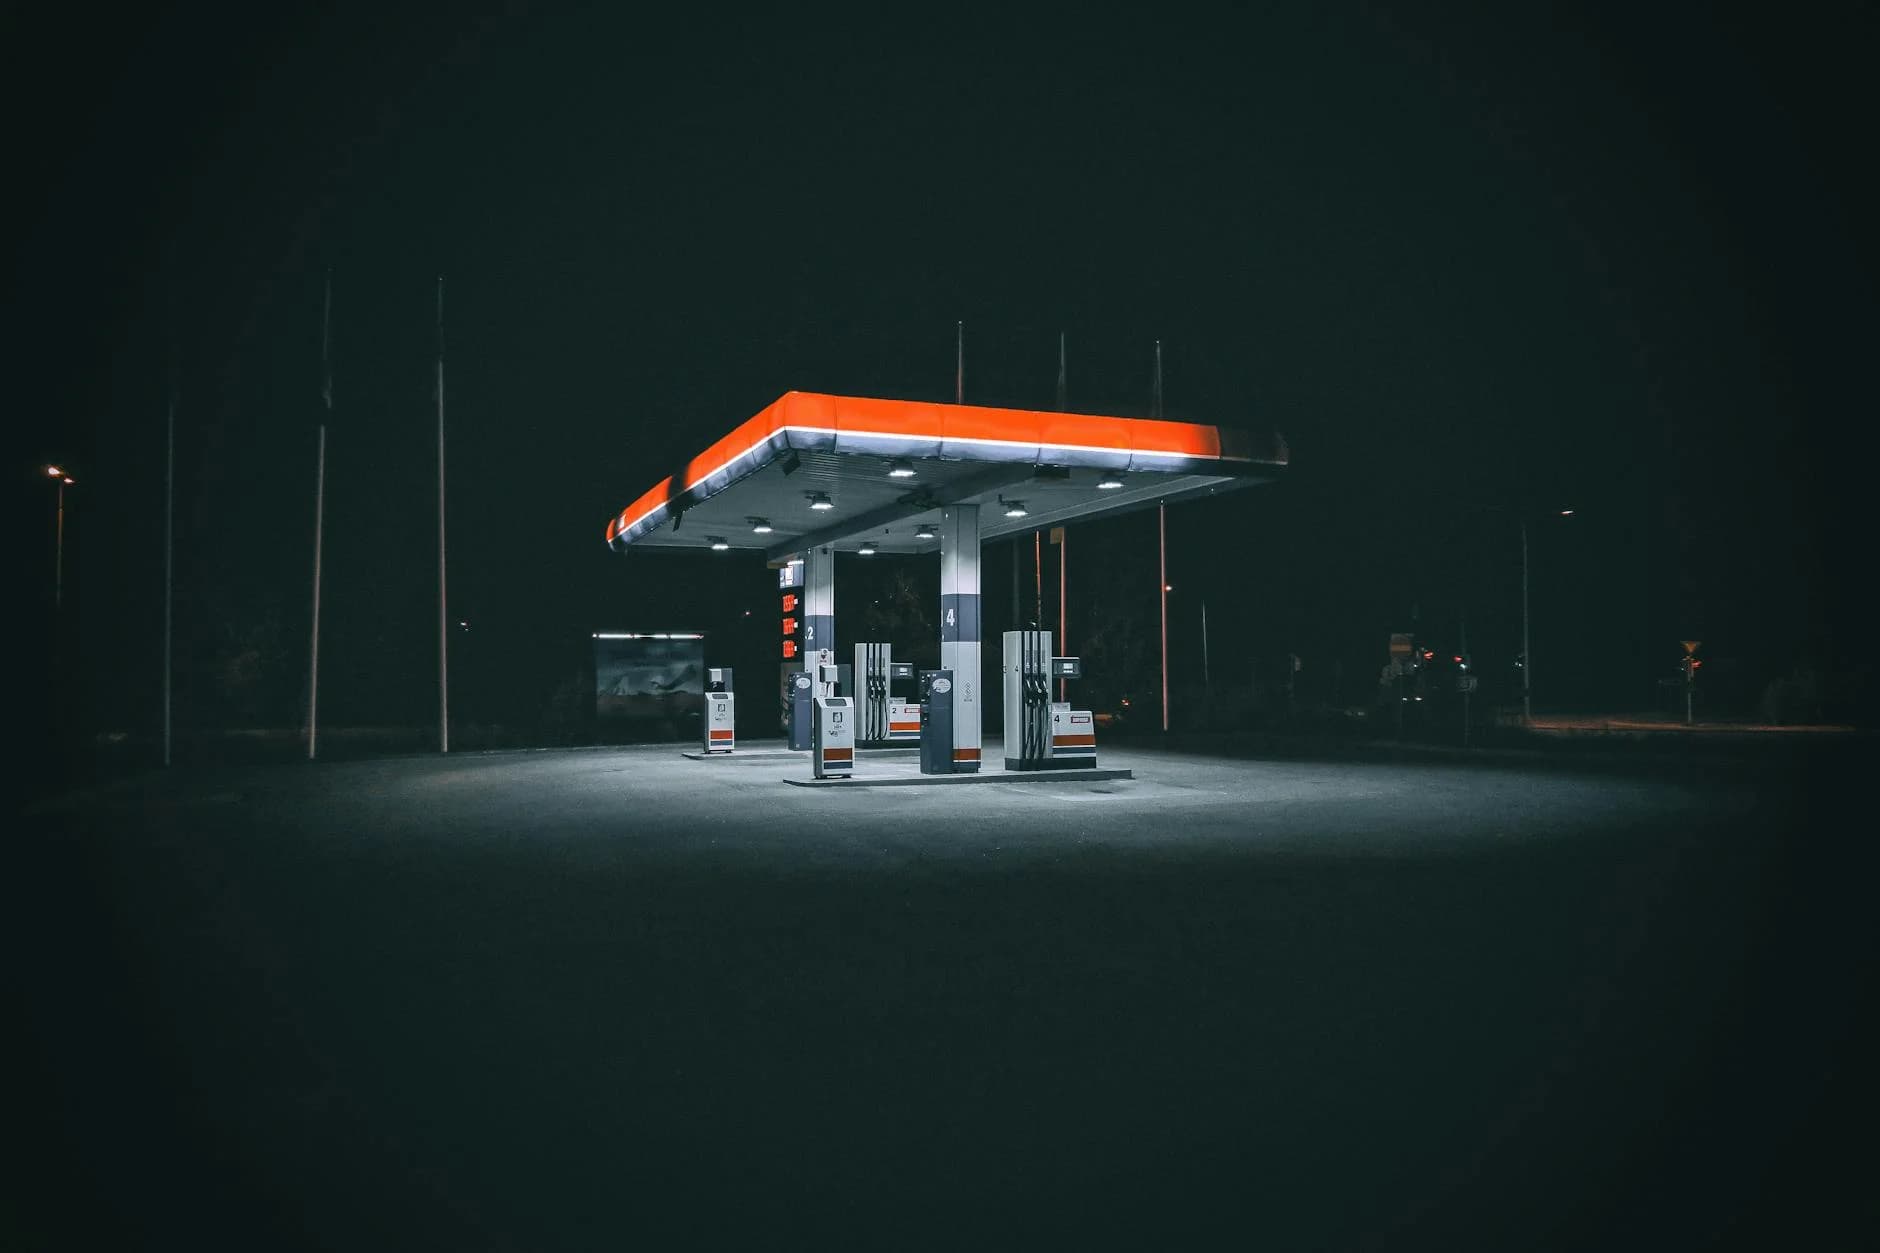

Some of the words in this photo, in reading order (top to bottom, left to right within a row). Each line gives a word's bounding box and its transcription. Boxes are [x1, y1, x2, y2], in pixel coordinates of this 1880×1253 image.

[946, 608, 955, 626] 4
[807, 626, 814, 640] 2
[1053, 714, 1060, 723] 4
